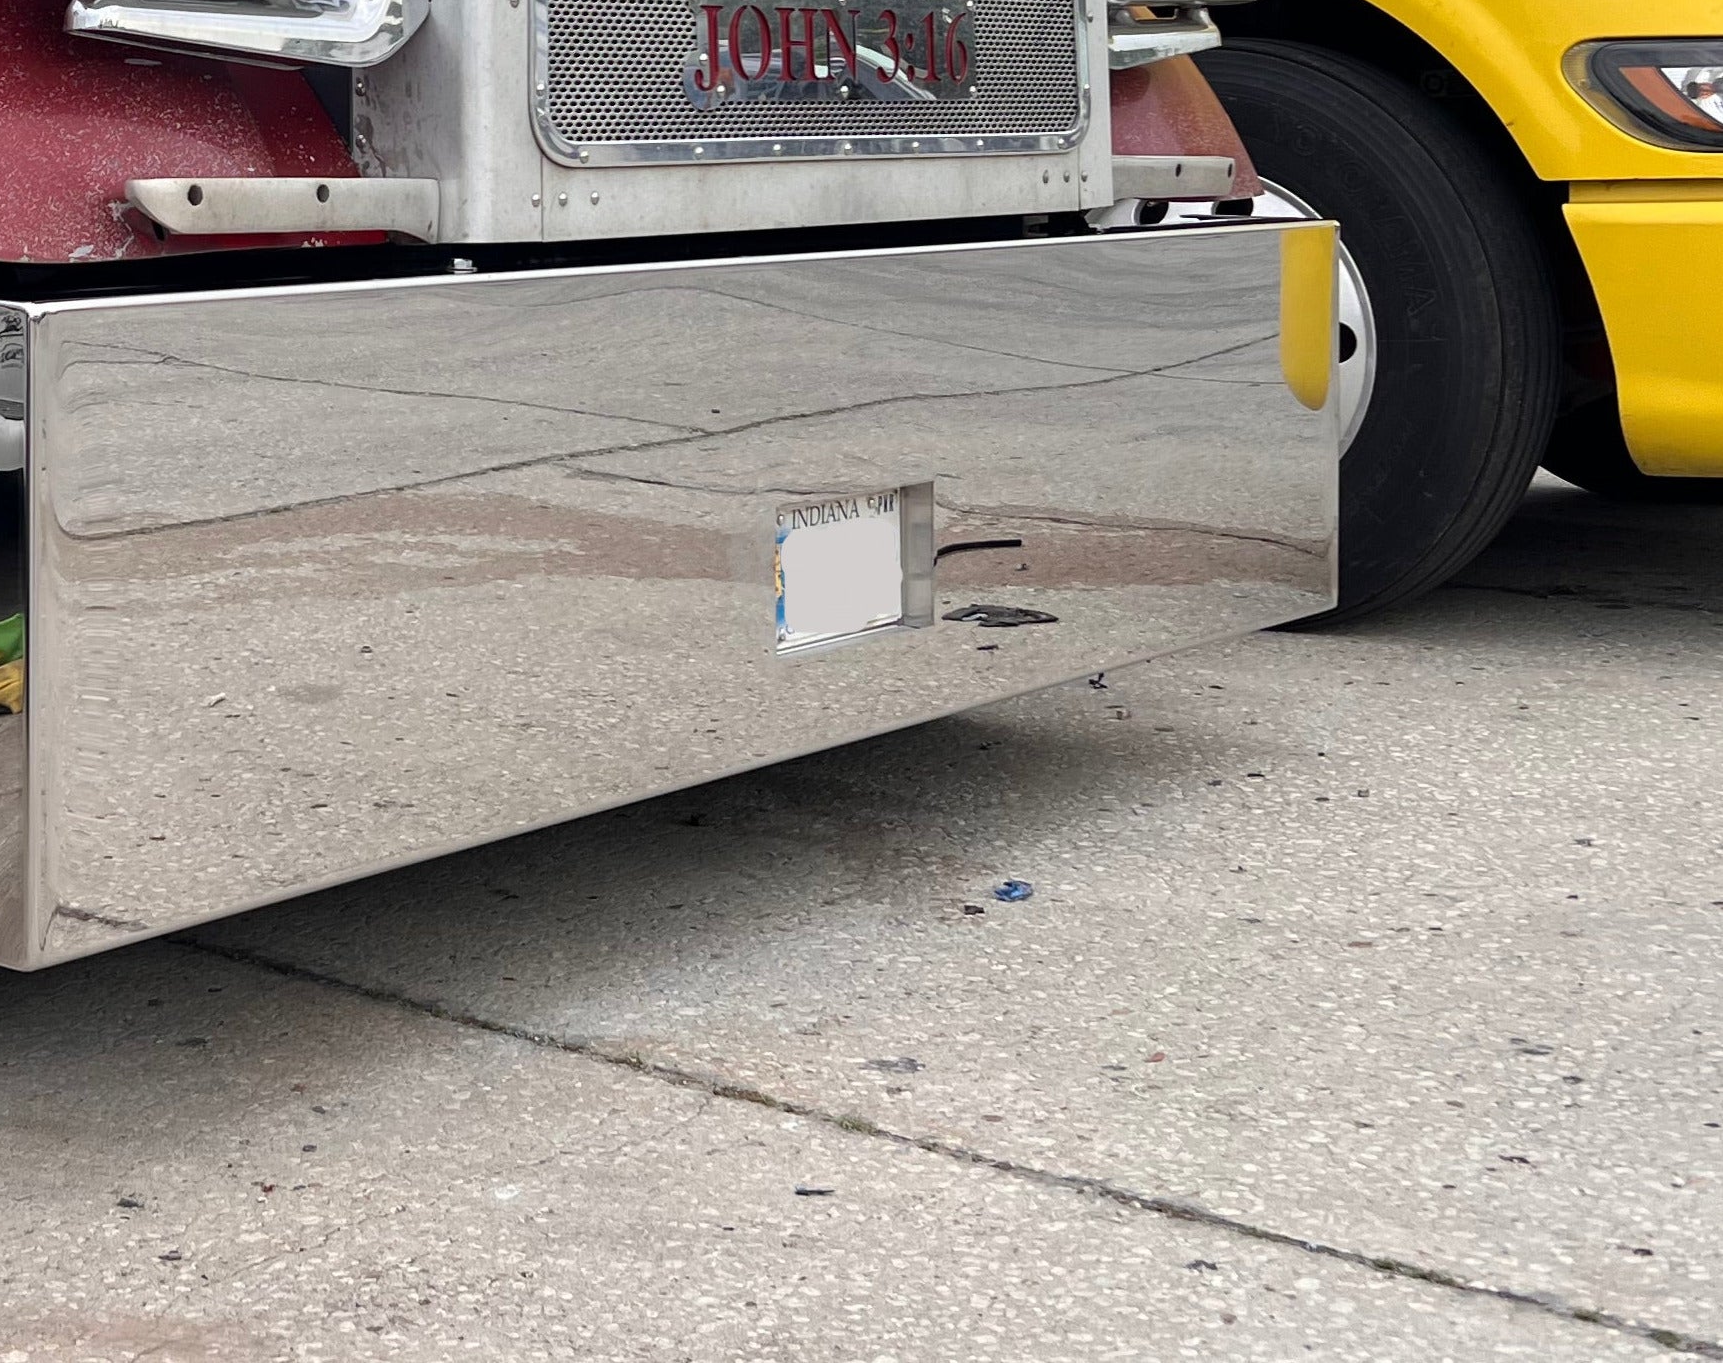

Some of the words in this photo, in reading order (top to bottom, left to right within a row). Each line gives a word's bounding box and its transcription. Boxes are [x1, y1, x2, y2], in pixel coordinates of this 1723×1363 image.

[694, 4, 861, 92] JOHN
[876, 8, 969, 86] 3:16
[791, 498, 861, 530] INDIANA
